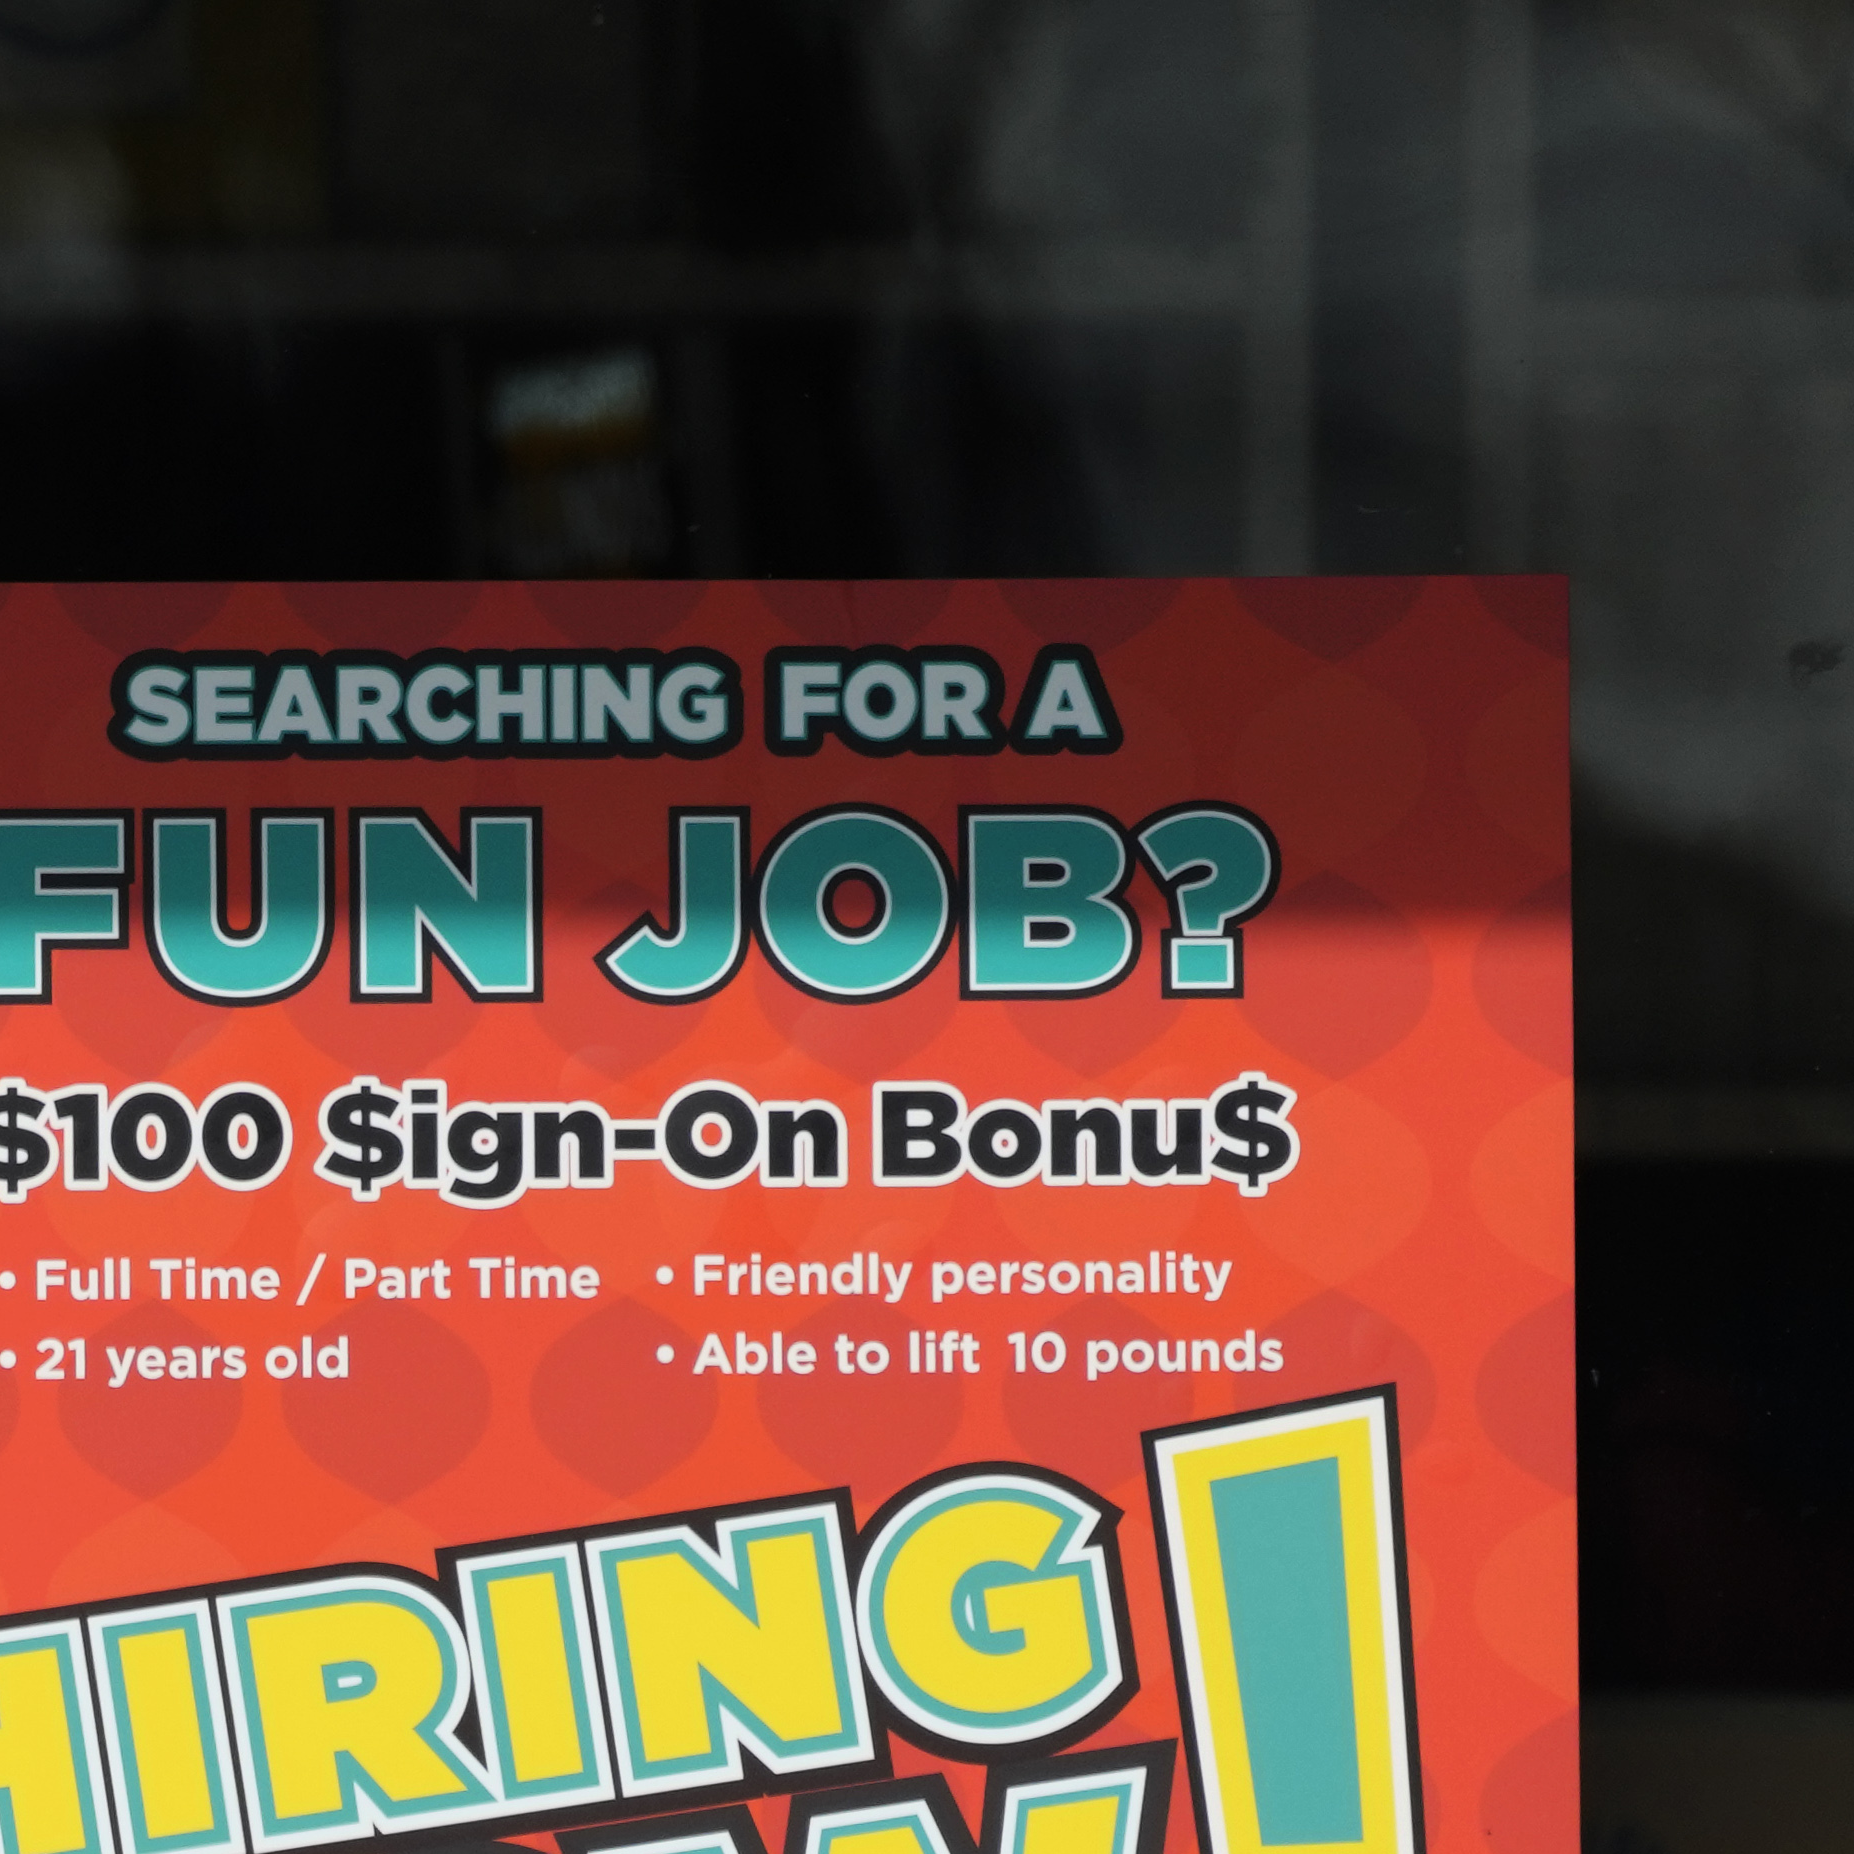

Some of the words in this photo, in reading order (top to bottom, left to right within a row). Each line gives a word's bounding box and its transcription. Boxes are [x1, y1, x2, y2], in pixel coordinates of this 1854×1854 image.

[127, 665, 725, 743] SEARCHING
[783, 663, 987, 739] FOR
[1028, 663, 1104, 735] A
[606, 811, 1271, 996] JOB?
[883, 1082, 1290, 1186] Bonu$
[37, 1258, 130, 1300] Full
[150, 1258, 280, 1299] Time
[345, 1258, 449, 1299] Part
[469, 1256, 599, 1298] Time
[694, 1252, 912, 1303] Friendly
[932, 1251, 1232, 1302] personality
[36, 1338, 85, 1379] 21
[106, 1346, 246, 1387] years
[265, 1336, 348, 1378] old
[693, 1332, 816, 1374] Able
[835, 1334, 889, 1374] to
[910, 1331, 980, 1373] lift
[1008, 1332, 1066, 1372] 10
[1087, 1330, 1283, 1380] pounds
